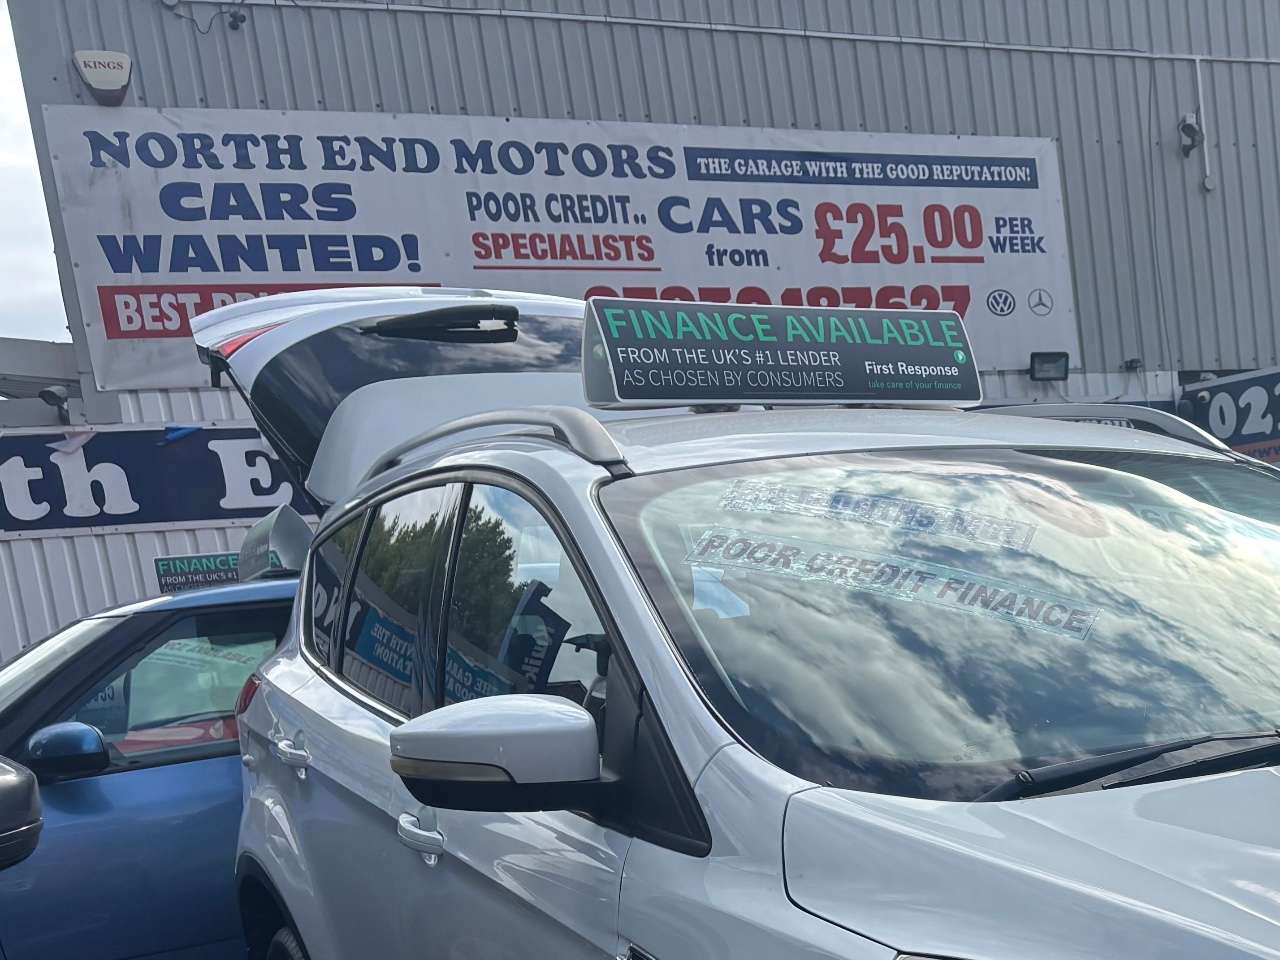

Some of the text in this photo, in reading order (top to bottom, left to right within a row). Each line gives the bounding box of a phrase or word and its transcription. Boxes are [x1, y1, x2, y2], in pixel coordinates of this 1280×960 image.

[82, 60, 124, 70] KINGS
[83, 131, 676, 180] NORTH END MOTORS
[697, 157, 1031, 182] THE GARAGE WITH THE GOOD REPUTATION!
[159, 182, 357, 222] CARS
[466, 192, 540, 224] POOR
[658, 197, 803, 236] CARS
[994, 216, 1035, 235] PER
[472, 231, 655, 262] SPECIALISTS
[814, 201, 984, 265] £25.00
[988, 236, 1047, 255] WEEK
[96, 234, 421, 274] WANTED!
[705, 243, 769, 267] from
[114, 292, 200, 332] BEST
[603, 308, 963, 348] FINANCE AVAILABLE
[617, 347, 841, 366] FROM THE UK'S #1 LENDER
[865, 361, 959, 378] First Response
[623, 369, 844, 387] AS CHOSEN BY CONSUMERS
[158, 555, 239, 575] FINANCE
[161, 575, 186, 585] FROM
[699, 532, 1091, 634] POOR CREDIT FINANCE
